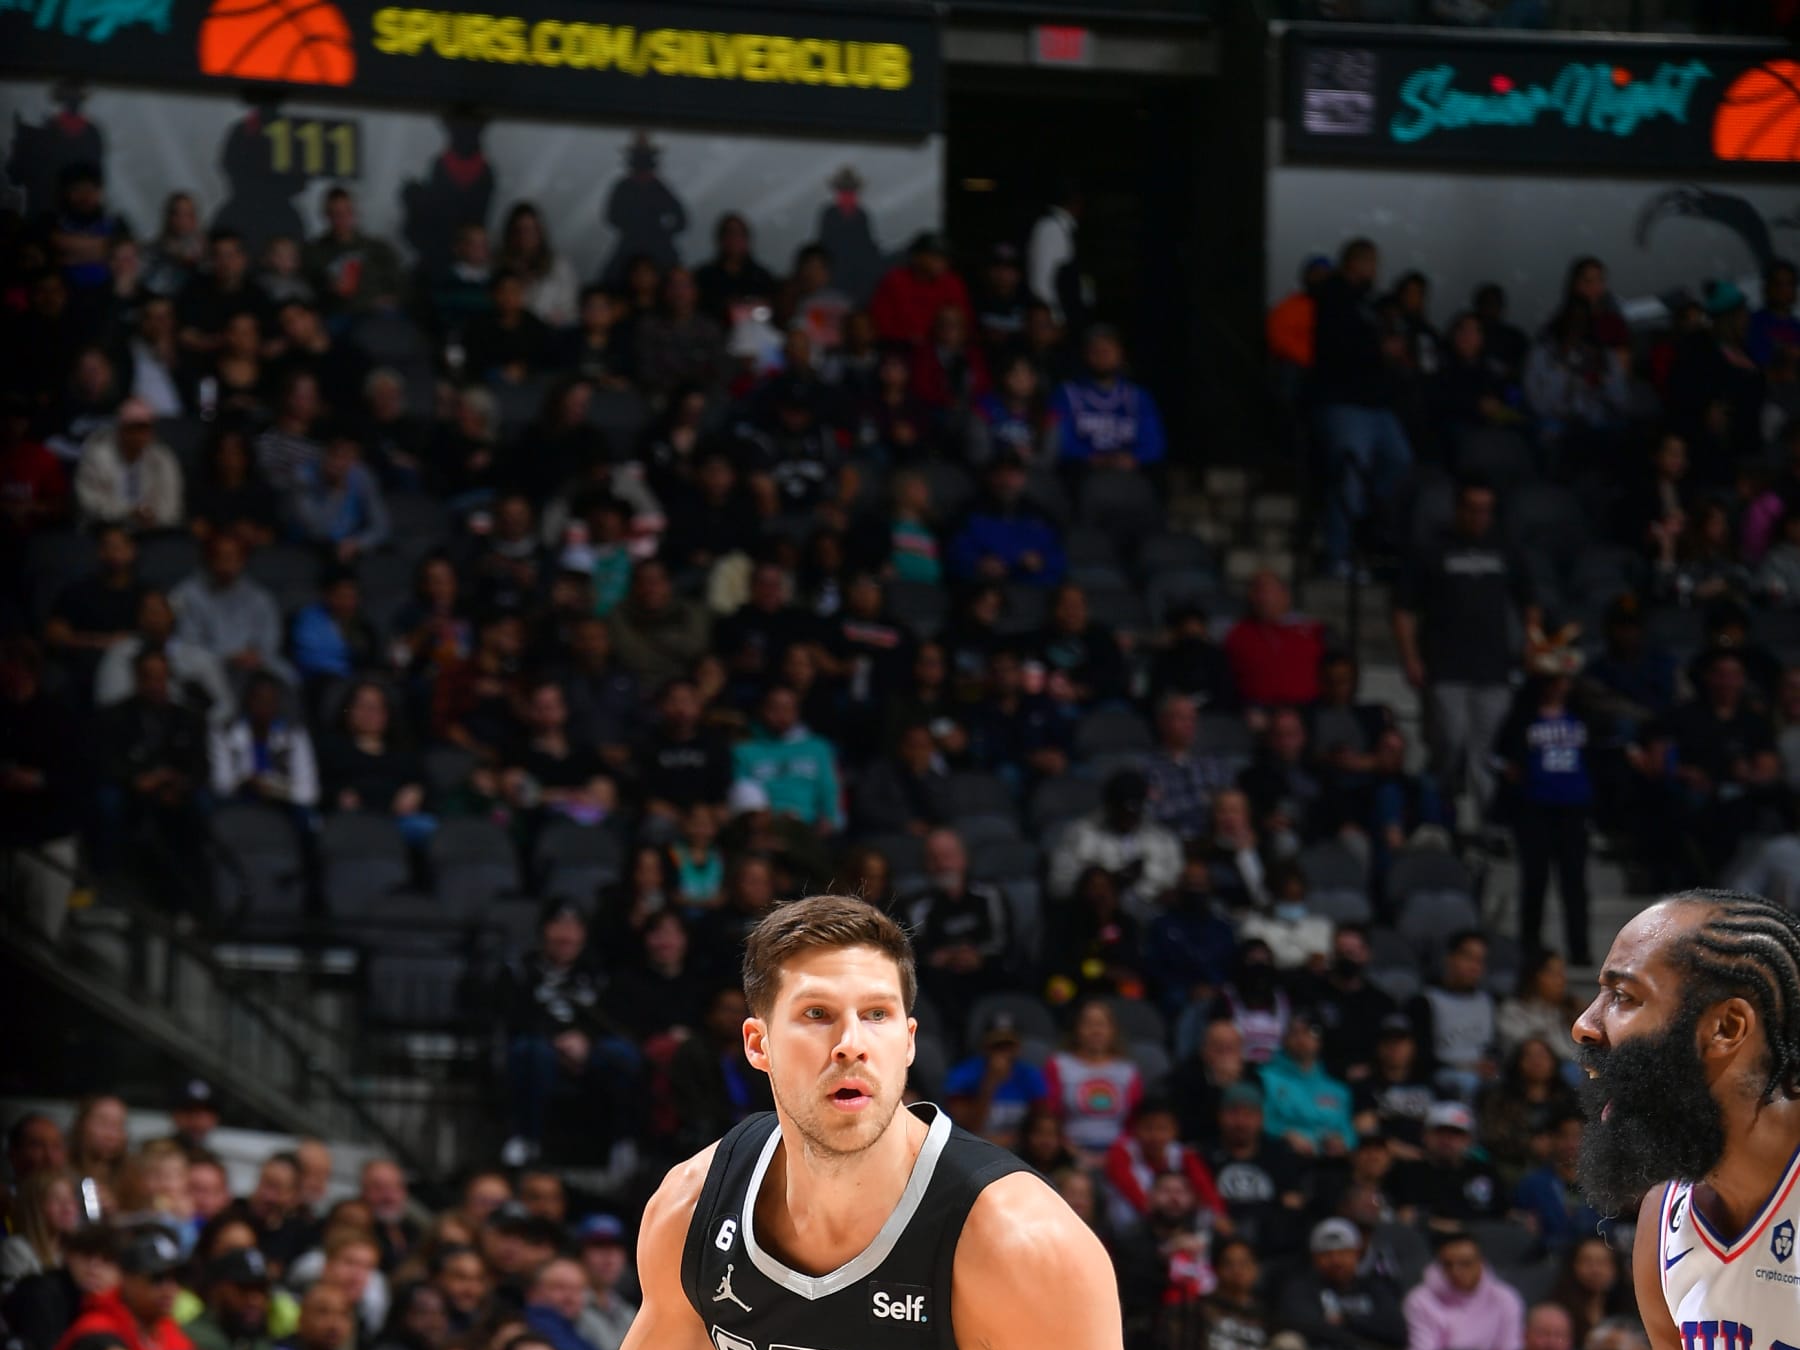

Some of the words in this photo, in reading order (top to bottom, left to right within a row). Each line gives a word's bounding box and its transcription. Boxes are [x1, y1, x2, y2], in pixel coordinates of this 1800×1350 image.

[373, 6, 912, 91] SPURS.COM/SILVERCLUB
[263, 120, 355, 176] 111
[715, 1219, 736, 1251] 6
[873, 1292, 928, 1322] Self.
